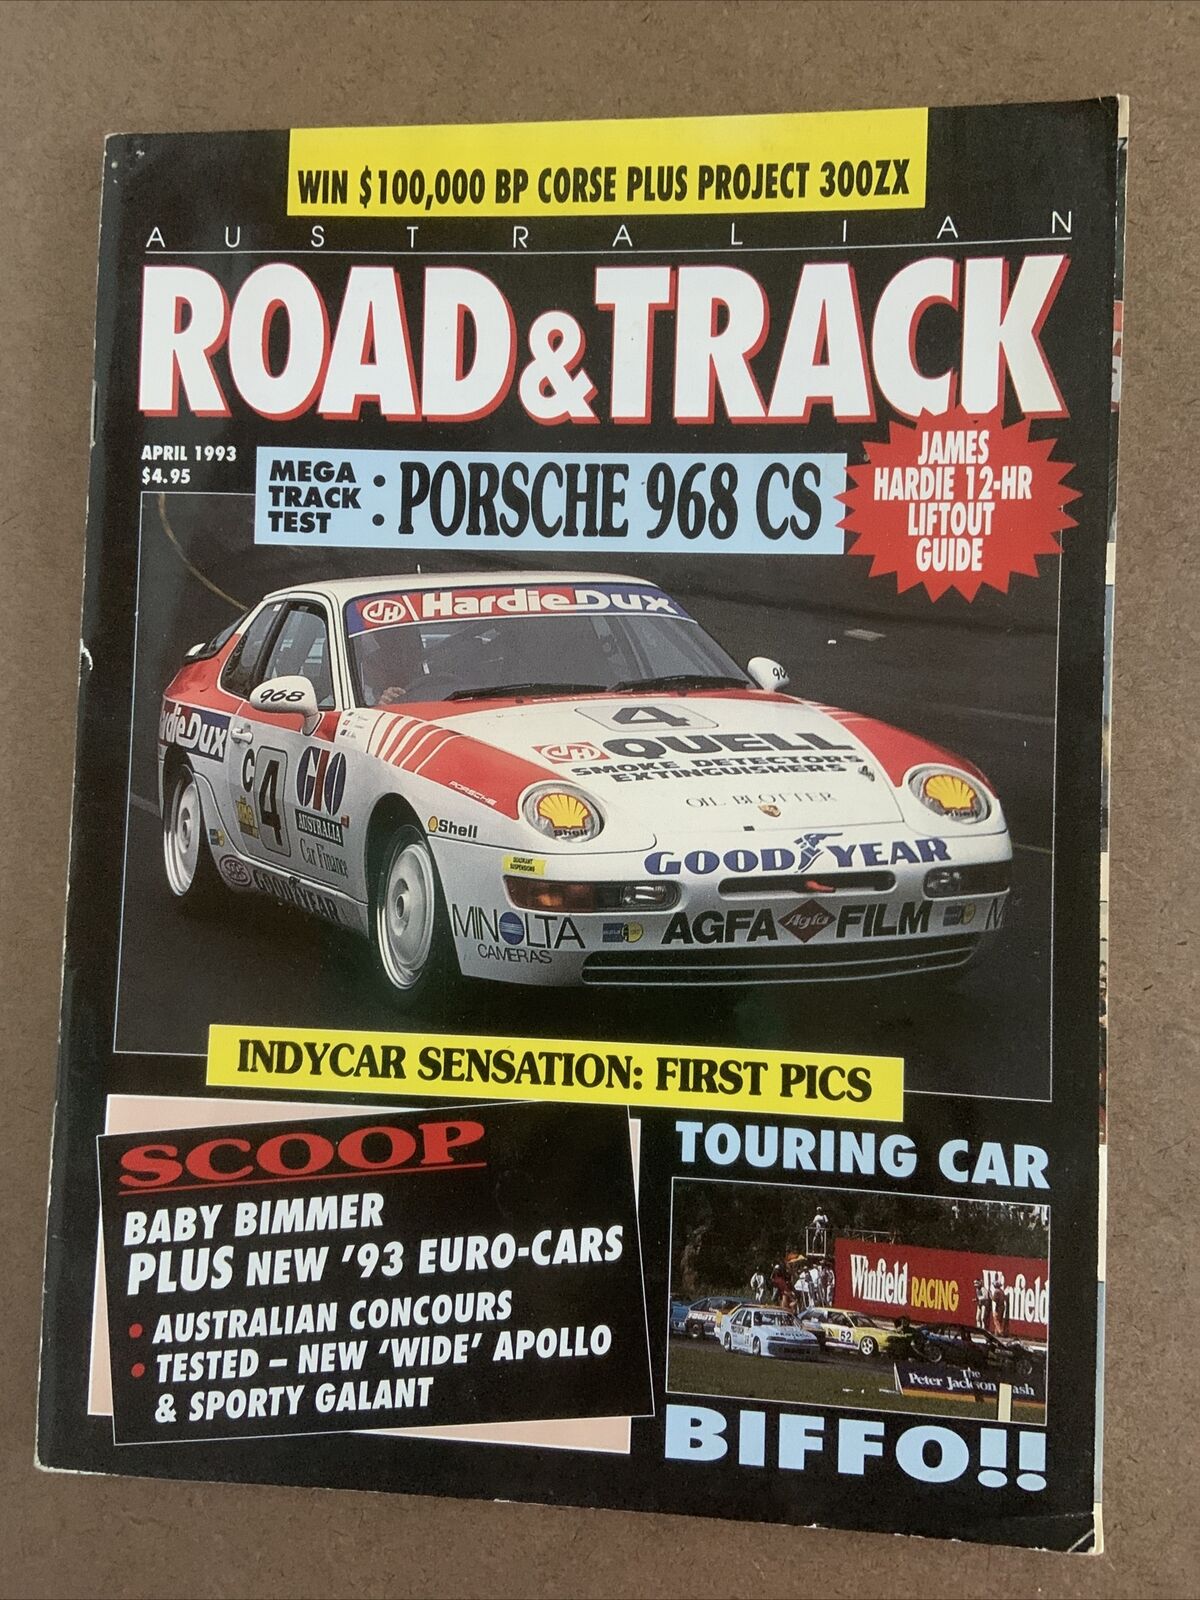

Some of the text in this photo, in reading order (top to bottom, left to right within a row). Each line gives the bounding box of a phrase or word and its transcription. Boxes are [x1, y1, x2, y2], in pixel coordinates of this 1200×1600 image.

[298, 158, 911, 211] WIN $100,000 BP CORSE PLUS PROJECT 300ZX
[145, 209, 1073, 249] AUSTRALIAN
[141, 445, 238, 463] APRIL 1993
[917, 429, 990, 466] JAMES
[141, 466, 192, 485] $4.95
[268, 460, 358, 484] MEGA
[873, 465, 1033, 501] HARDIE 12-HR
[268, 485, 363, 510] TRACK
[397, 460, 630, 539] PORSCHE
[645, 461, 740, 541] 968
[755, 462, 823, 541] CS
[267, 511, 333, 534] TEST
[906, 501, 996, 537] LIFTOUT
[915, 538, 984, 572] GUIDE
[420, 588, 679, 619] HardieDux
[259, 688, 306, 704] 968
[610, 705, 691, 728] 4
[602, 732, 856, 758] QUELL
[571, 755, 866, 778] SMOKE DETECTORS
[612, 764, 849, 783] EXTINGUISHERS
[258, 759, 283, 848] 4
[448, 780, 498, 807] PORSCHE
[686, 791, 836, 809] OIL BLOTTER
[297, 812, 343, 844] AUSTRALIA
[438, 818, 479, 839] Shell
[301, 838, 349, 880] Car Finance
[451, 903, 586, 949] MINOLTA
[661, 907, 779, 945] AGFA
[835, 899, 934, 938] FILM
[477, 943, 553, 964] CAMERAS
[237, 1038, 873, 1102] INDYCAR SENSATION: FIRST PICS
[119, 1120, 486, 1188] SCOOP
[676, 1121, 1051, 1189] TOURING CAR
[123, 1192, 385, 1246] BABY BIMMER
[127, 1225, 624, 1296] PLUS NEW '93 EURO-CARS
[850, 1253, 960, 1312] Winfield RACING
[982, 1269, 1049, 1326] Wnfield
[152, 1290, 513, 1345] AUSTRALIAN CONCOURS
[156, 1347, 260, 1383] TESTED
[298, 1340, 367, 1374] NEW
[493, 1325, 612, 1362] APOLLO
[839, 1330, 853, 1343] 52
[154, 1377, 434, 1424] & SPORTY GALANT
[908, 1372, 943, 1387] Peter
[1012, 1383, 1035, 1396] ash
[664, 1403, 1047, 1492] BIFFO!!
